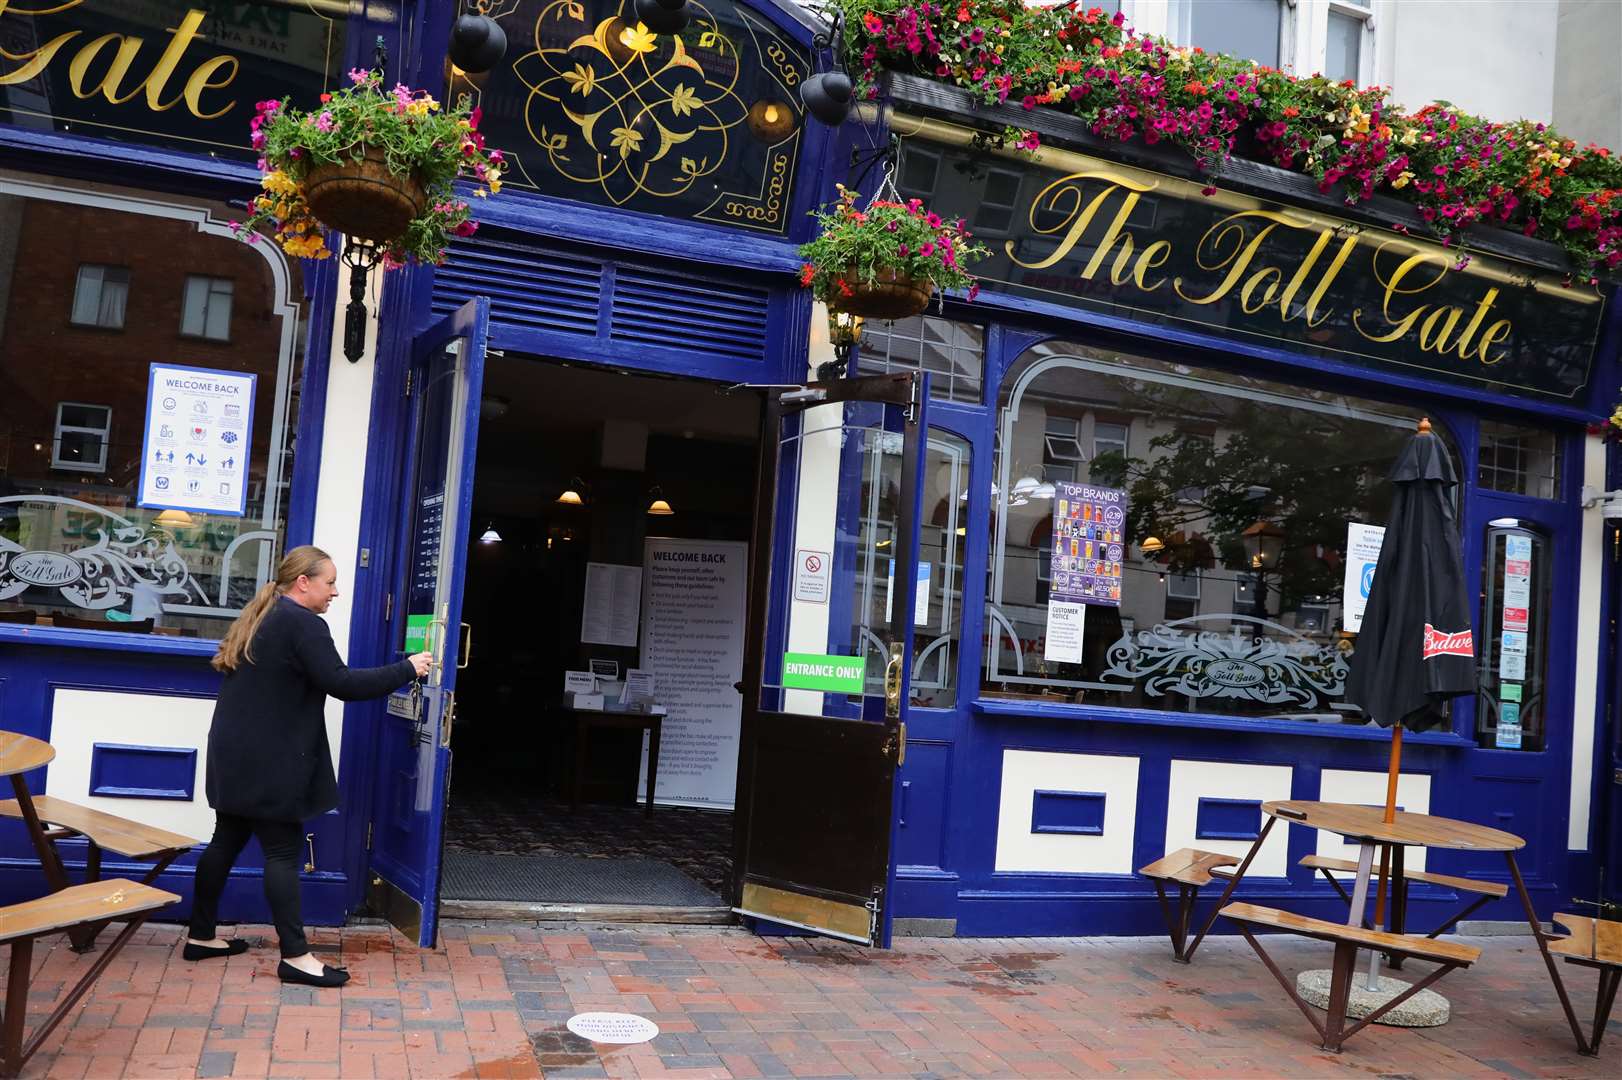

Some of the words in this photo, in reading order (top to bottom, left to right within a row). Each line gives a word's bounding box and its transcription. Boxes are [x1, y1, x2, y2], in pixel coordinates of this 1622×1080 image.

[1005, 170, 1171, 292] The
[1174, 209, 1359, 328] Toll
[1353, 238, 1512, 366] Gate
[166, 378, 212, 392] WELCOME
[214, 383, 240, 395] BACK
[1063, 484, 1082, 497] TOP
[1083, 488, 1119, 502] BRANDS
[653, 551, 699, 563] WELCOME
[701, 553, 727, 564] BACK
[16, 560, 45, 580] Toll
[45, 564, 74, 582] Gate
[1052, 606, 1079, 615] CUSTOMER
[1052, 613, 1070, 621] NOTICE
[785, 662, 834, 677] ENTRANCE
[836, 666, 862, 680] ONLY
[1227, 661, 1244, 671] The
[1214, 670, 1235, 681] Toll
[1235, 672, 1257, 683] Gate
